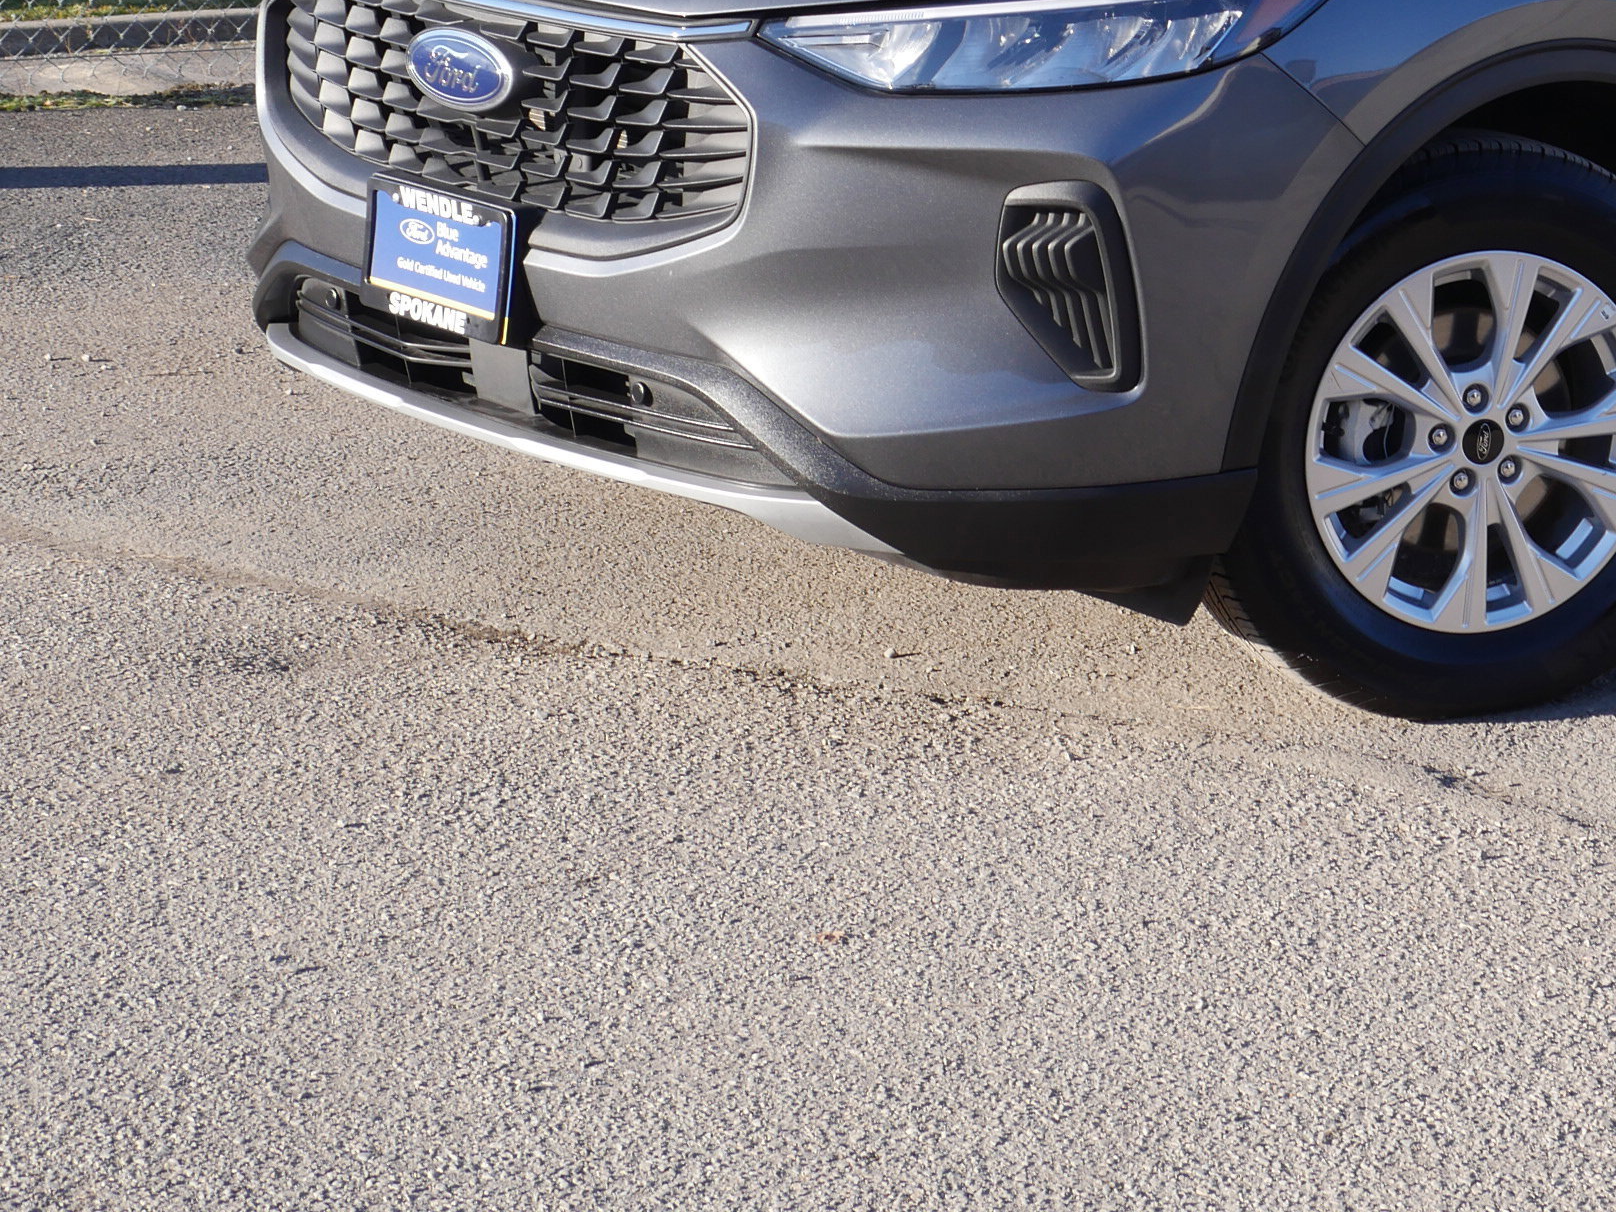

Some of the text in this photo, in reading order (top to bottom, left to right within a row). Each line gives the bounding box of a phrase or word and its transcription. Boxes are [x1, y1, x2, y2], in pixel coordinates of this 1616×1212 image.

[424, 43, 483, 94] Ford
[399, 185, 475, 226] WENDLE
[437, 221, 460, 243] Blue
[397, 256, 415, 273] Gold
[435, 240, 488, 270] Advantage
[388, 291, 468, 335] SPOKANE
